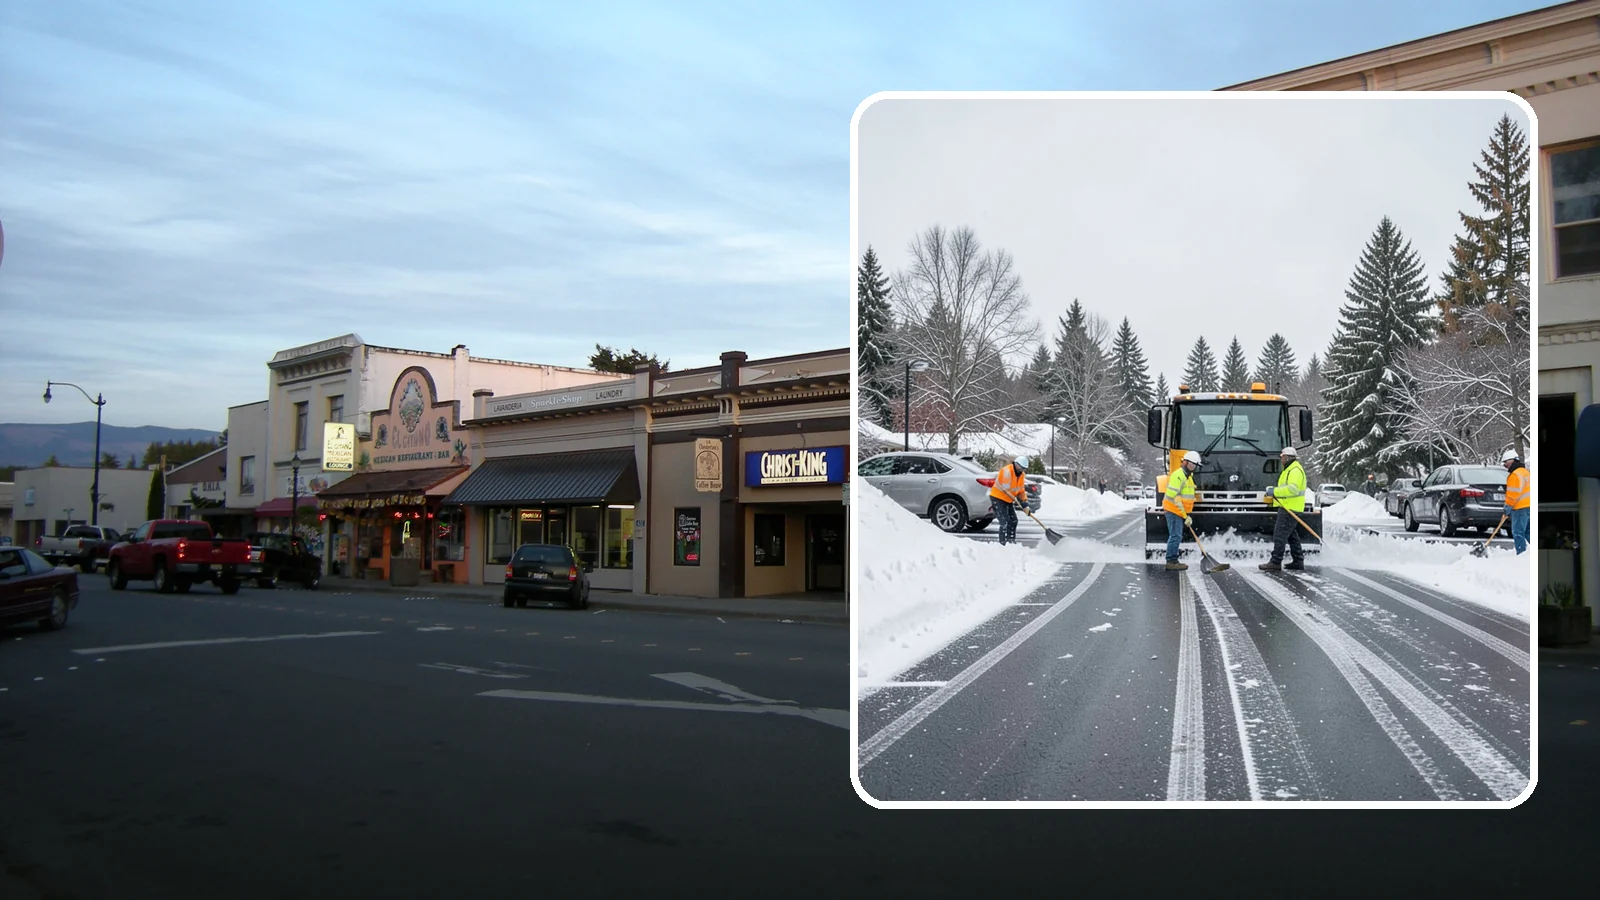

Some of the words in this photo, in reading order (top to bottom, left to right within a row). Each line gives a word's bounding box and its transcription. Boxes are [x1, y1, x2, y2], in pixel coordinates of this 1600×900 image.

[493, 402, 523, 413] LAVANDERIA
[530, 396, 561, 409] Sparkle
[562, 394, 582, 404] Shop
[595, 389, 624, 399] LAUNDRY
[373, 454, 396, 464] MEXICAN
[397, 451, 433, 462] RESTAURANT
[438, 450, 450, 459] BAR
[761, 452, 797, 478] CHRIST
[799, 450, 827, 476] KING
